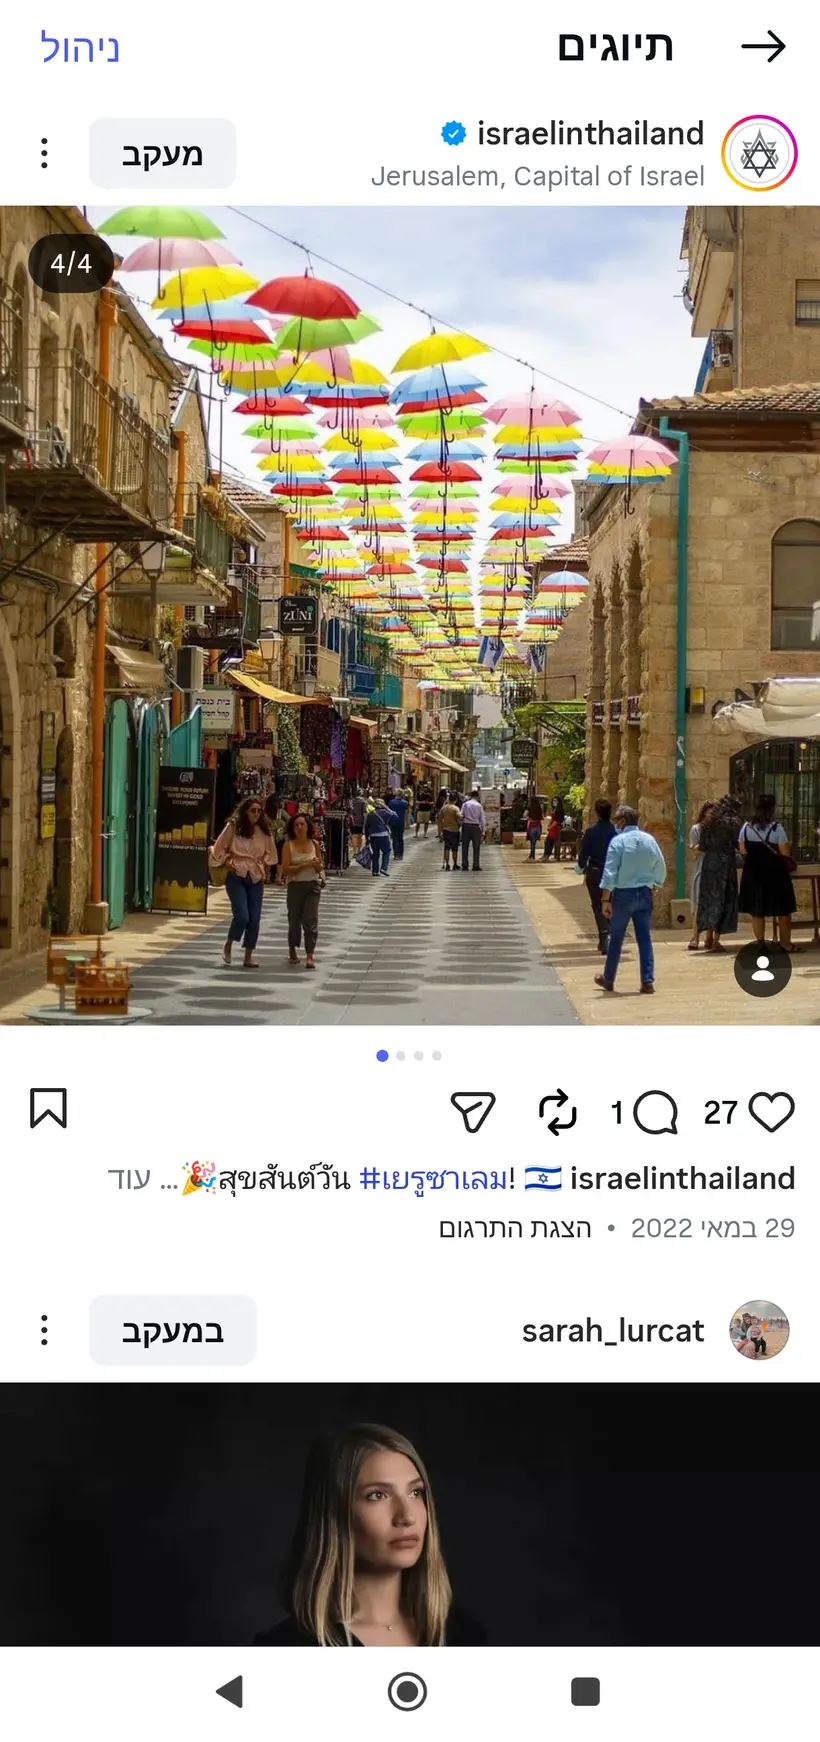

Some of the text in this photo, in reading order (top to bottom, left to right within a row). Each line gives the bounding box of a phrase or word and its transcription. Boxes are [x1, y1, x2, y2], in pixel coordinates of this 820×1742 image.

[40, 29, 120, 64] ניהול
[558, 33, 673, 62] תיוגים
[478, 119, 704, 146] israelinthailand
[122, 145, 203, 173] מעקב
[371, 164, 705, 193] Jerusalem, Capital of Israel
[217, 698, 231, 706] בית
[611, 1100, 622, 1125] 1
[704, 1099, 739, 1125] 27
[107, 1169, 151, 1191] עוד
[218, 1162, 352, 1198] สุขสันต์วัน
[570, 1165, 795, 1191] israelinthailand
[439, 1220, 592, 1239] הצגת התרגום
[631, 1217, 795, 1238] 29 במאי 2022
[122, 1322, 225, 1349] במעקב
[522, 1316, 705, 1347] sarah_lurcat
